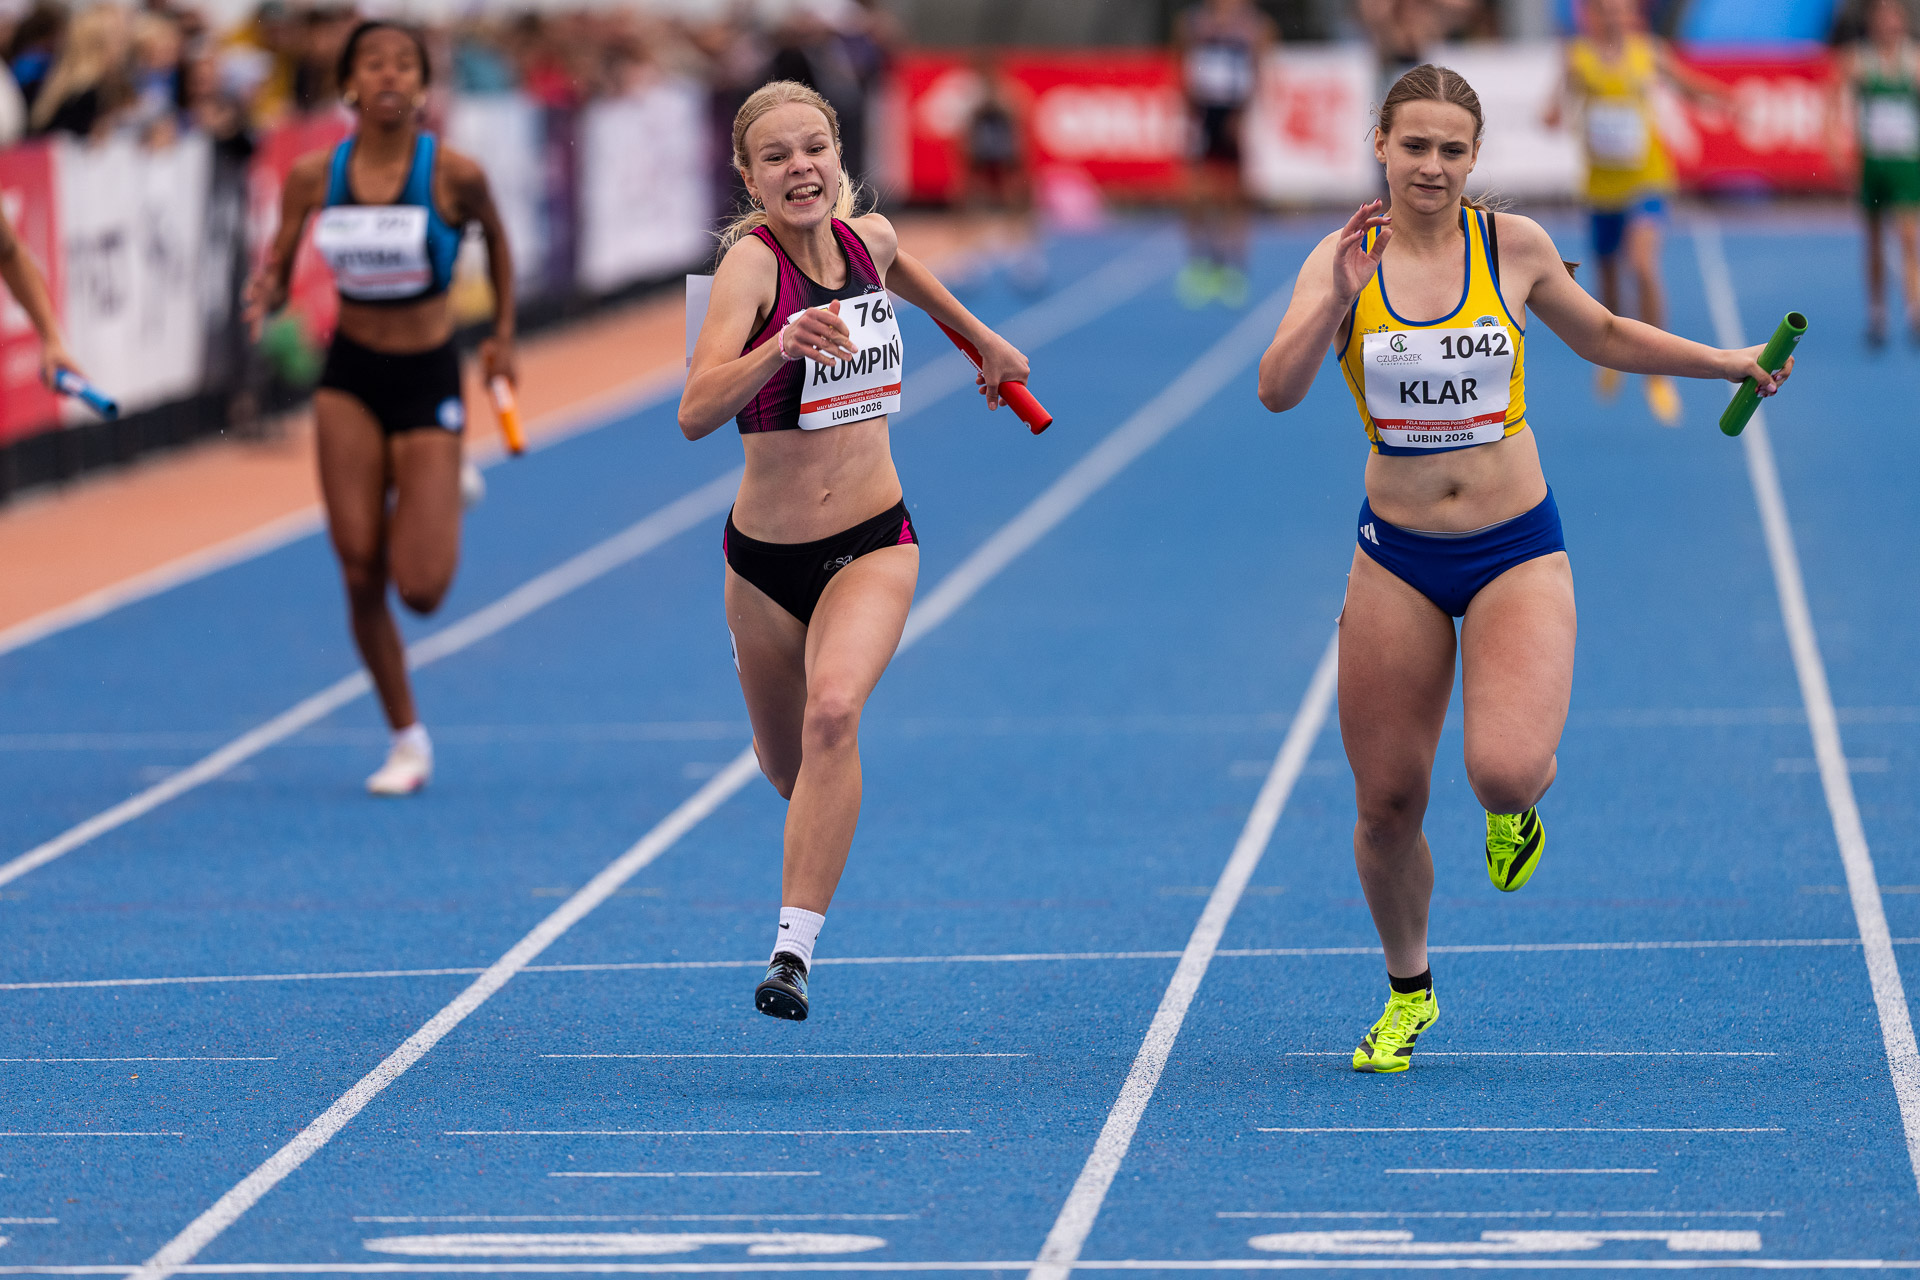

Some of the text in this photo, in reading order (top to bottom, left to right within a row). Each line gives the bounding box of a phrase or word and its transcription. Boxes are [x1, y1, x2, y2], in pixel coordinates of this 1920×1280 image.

[1439, 332, 1510, 360] 1042
[1376, 353, 1423, 363] CZUBASZEK
[1399, 378, 1478, 405] KLAR
[848, 395, 866, 406] JANUSZA
[832, 401, 883, 421] LUBIN 2026
[1406, 432, 1474, 443] LUBIN 2026
